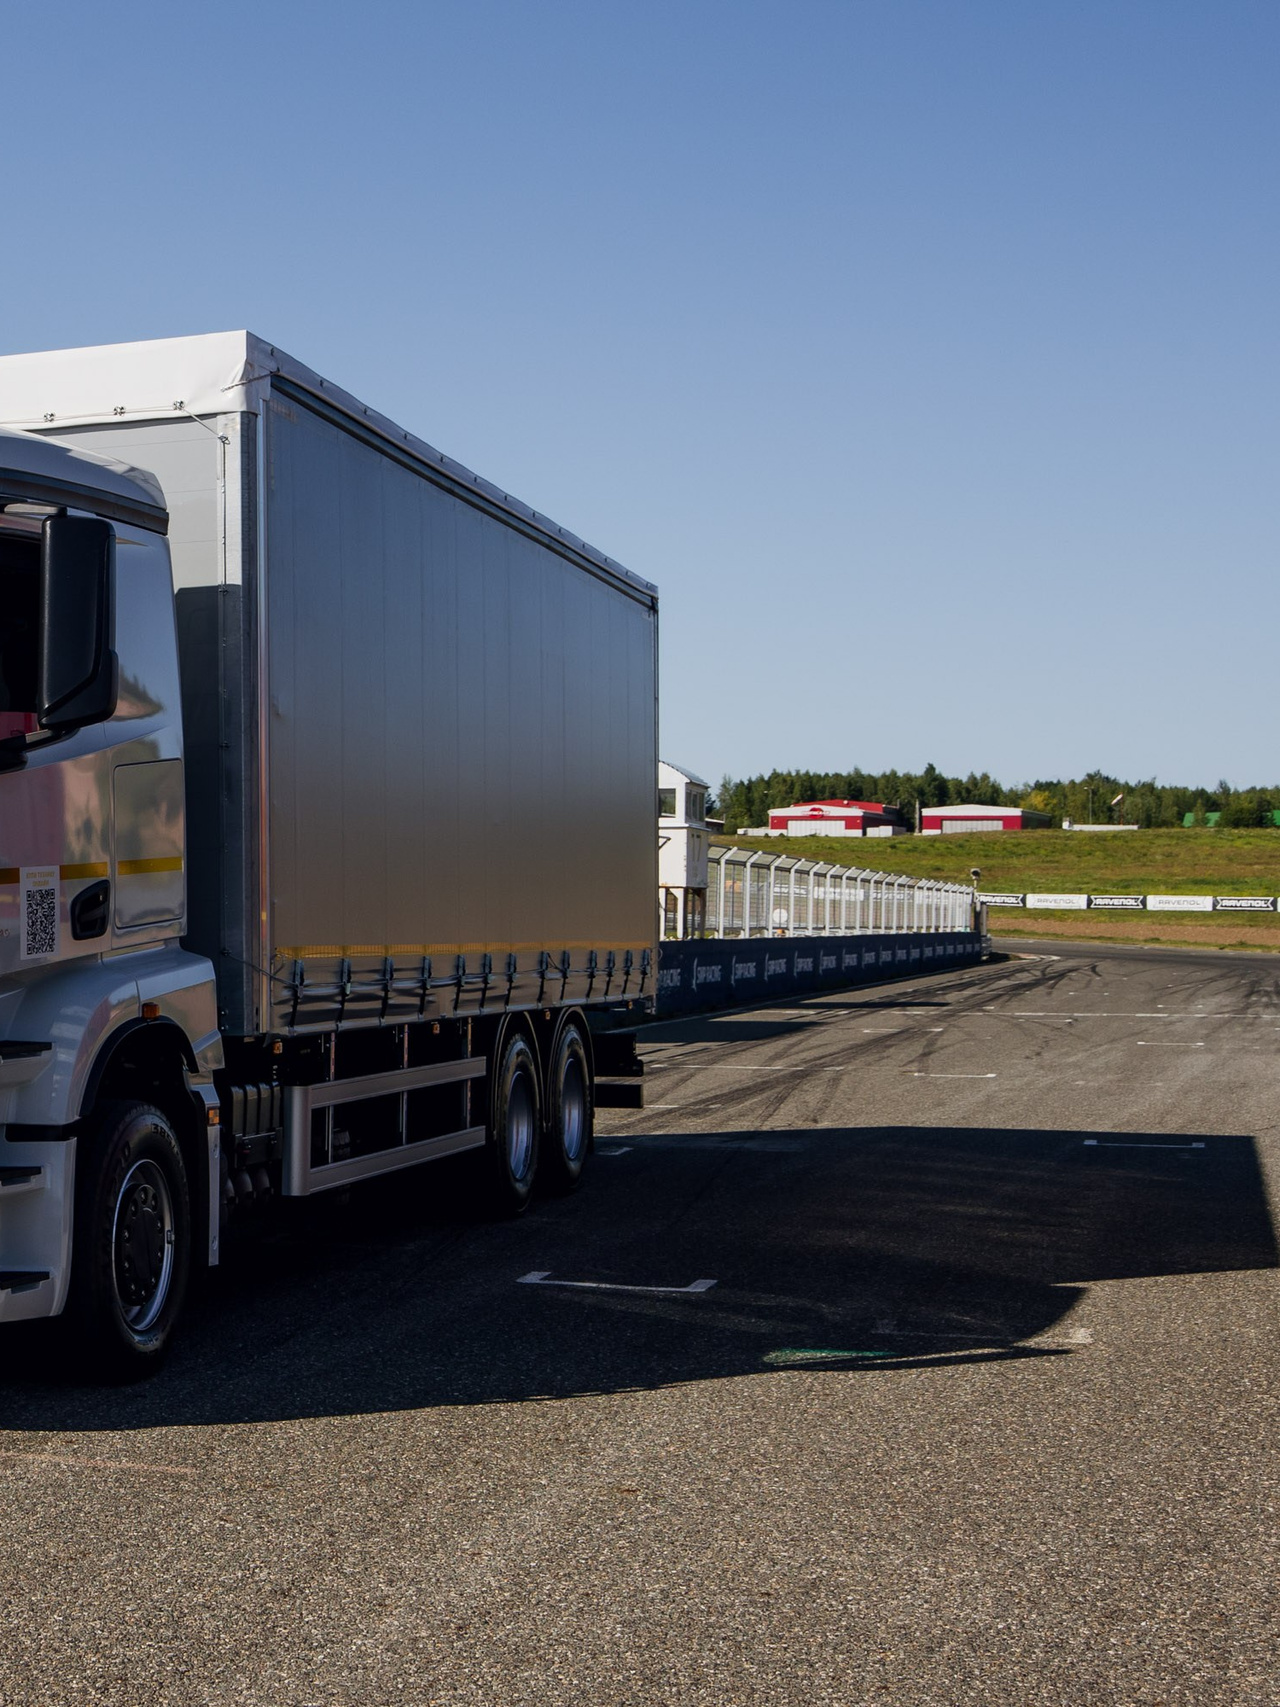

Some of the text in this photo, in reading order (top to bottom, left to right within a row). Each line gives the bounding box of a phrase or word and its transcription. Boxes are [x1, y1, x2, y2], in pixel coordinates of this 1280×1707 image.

[979, 895, 1019, 904] RAVENOL
[1036, 897, 1078, 905] RAVENOL
[1095, 898, 1138, 907] RAVENOL
[1221, 899, 1268, 908] RAVENOL
